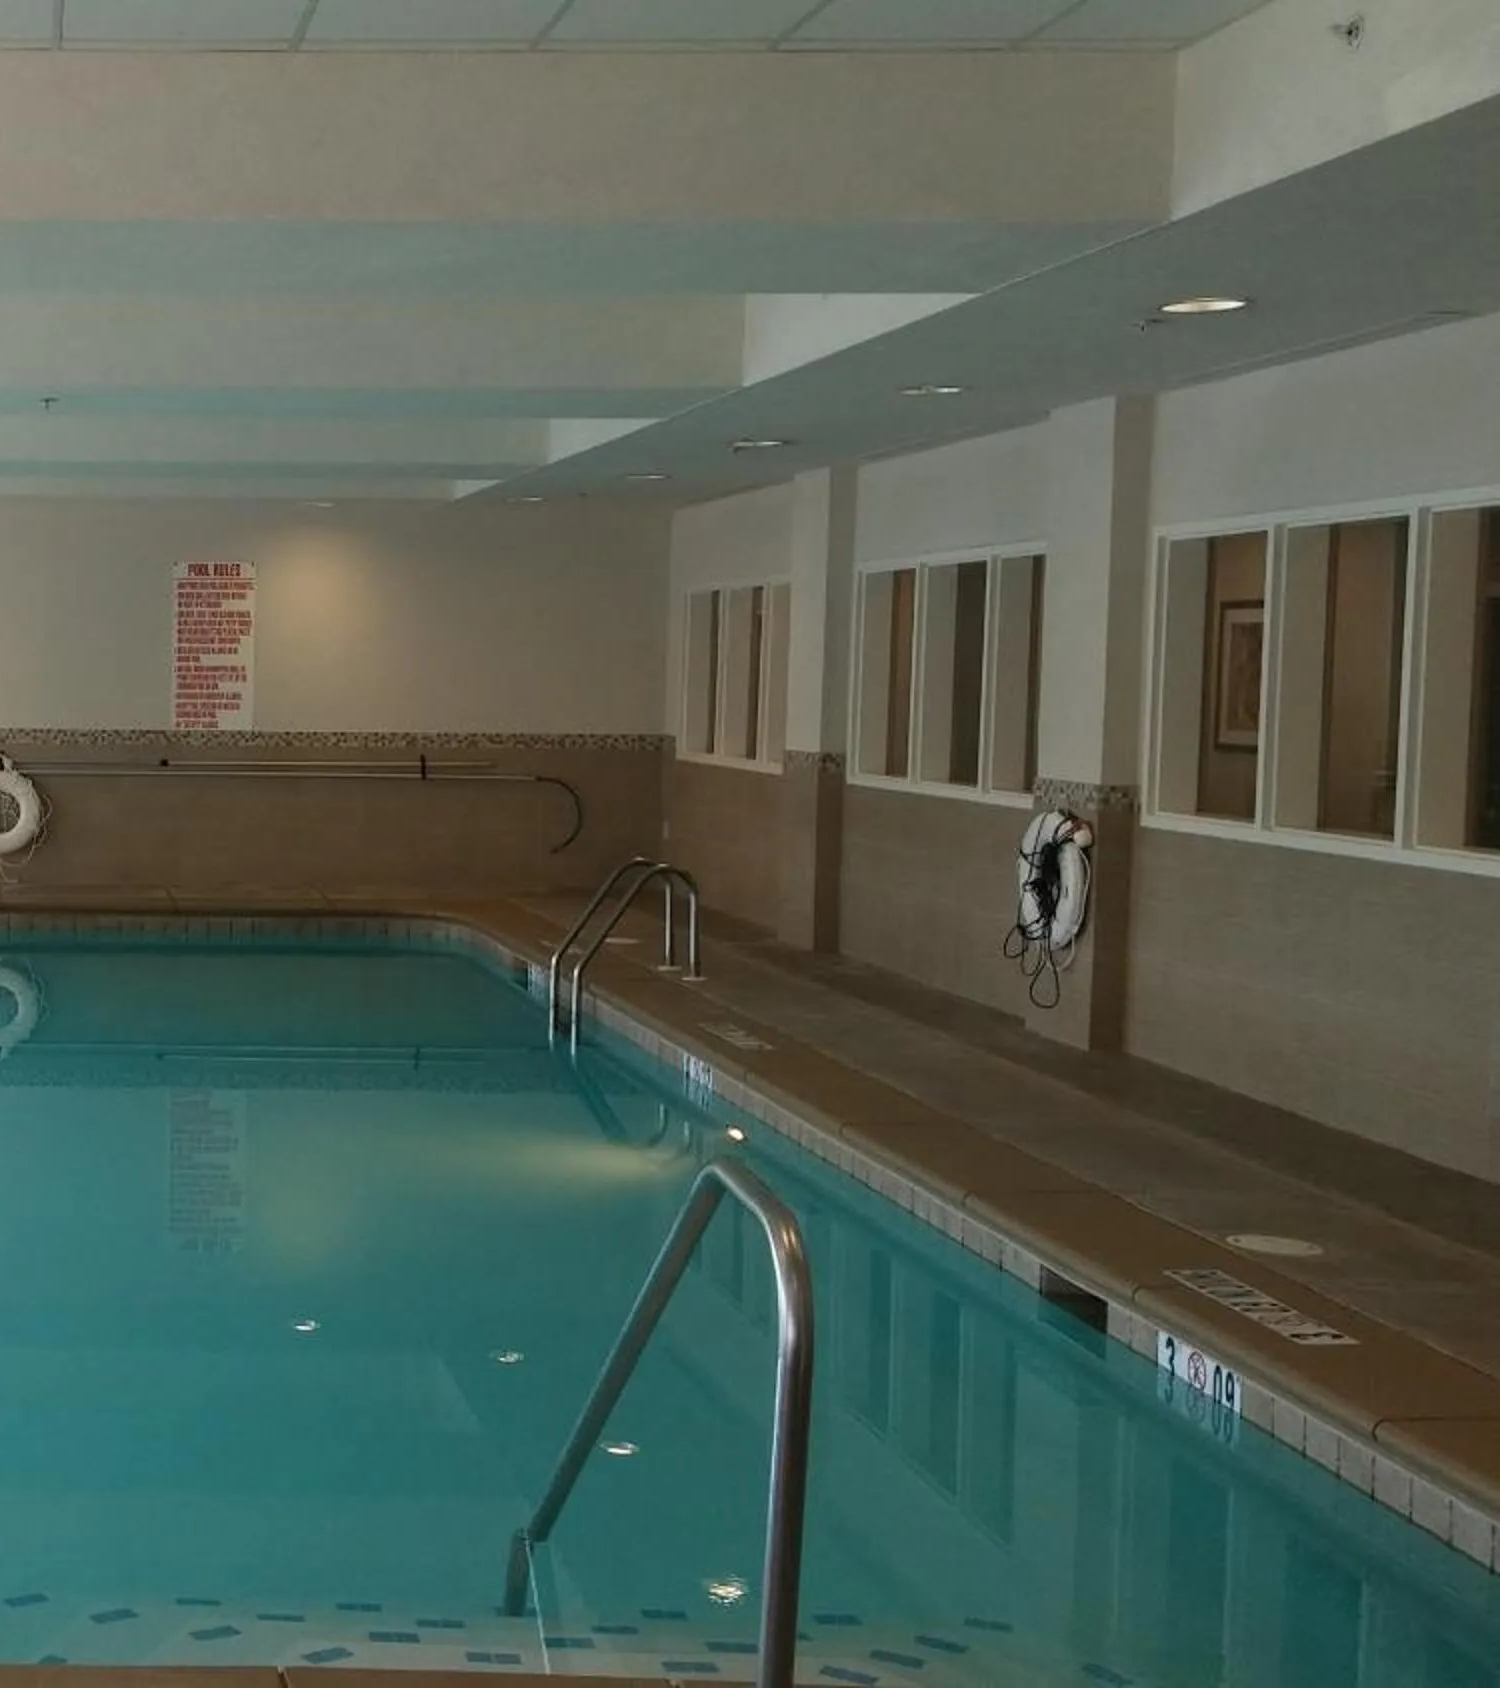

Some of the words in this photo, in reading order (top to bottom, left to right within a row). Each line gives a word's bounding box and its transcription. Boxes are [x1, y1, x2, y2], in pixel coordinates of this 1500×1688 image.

[188, 563, 210, 576] POOL
[213, 563, 241, 576] RULES
[1213, 1364, 1235, 1411] 09
